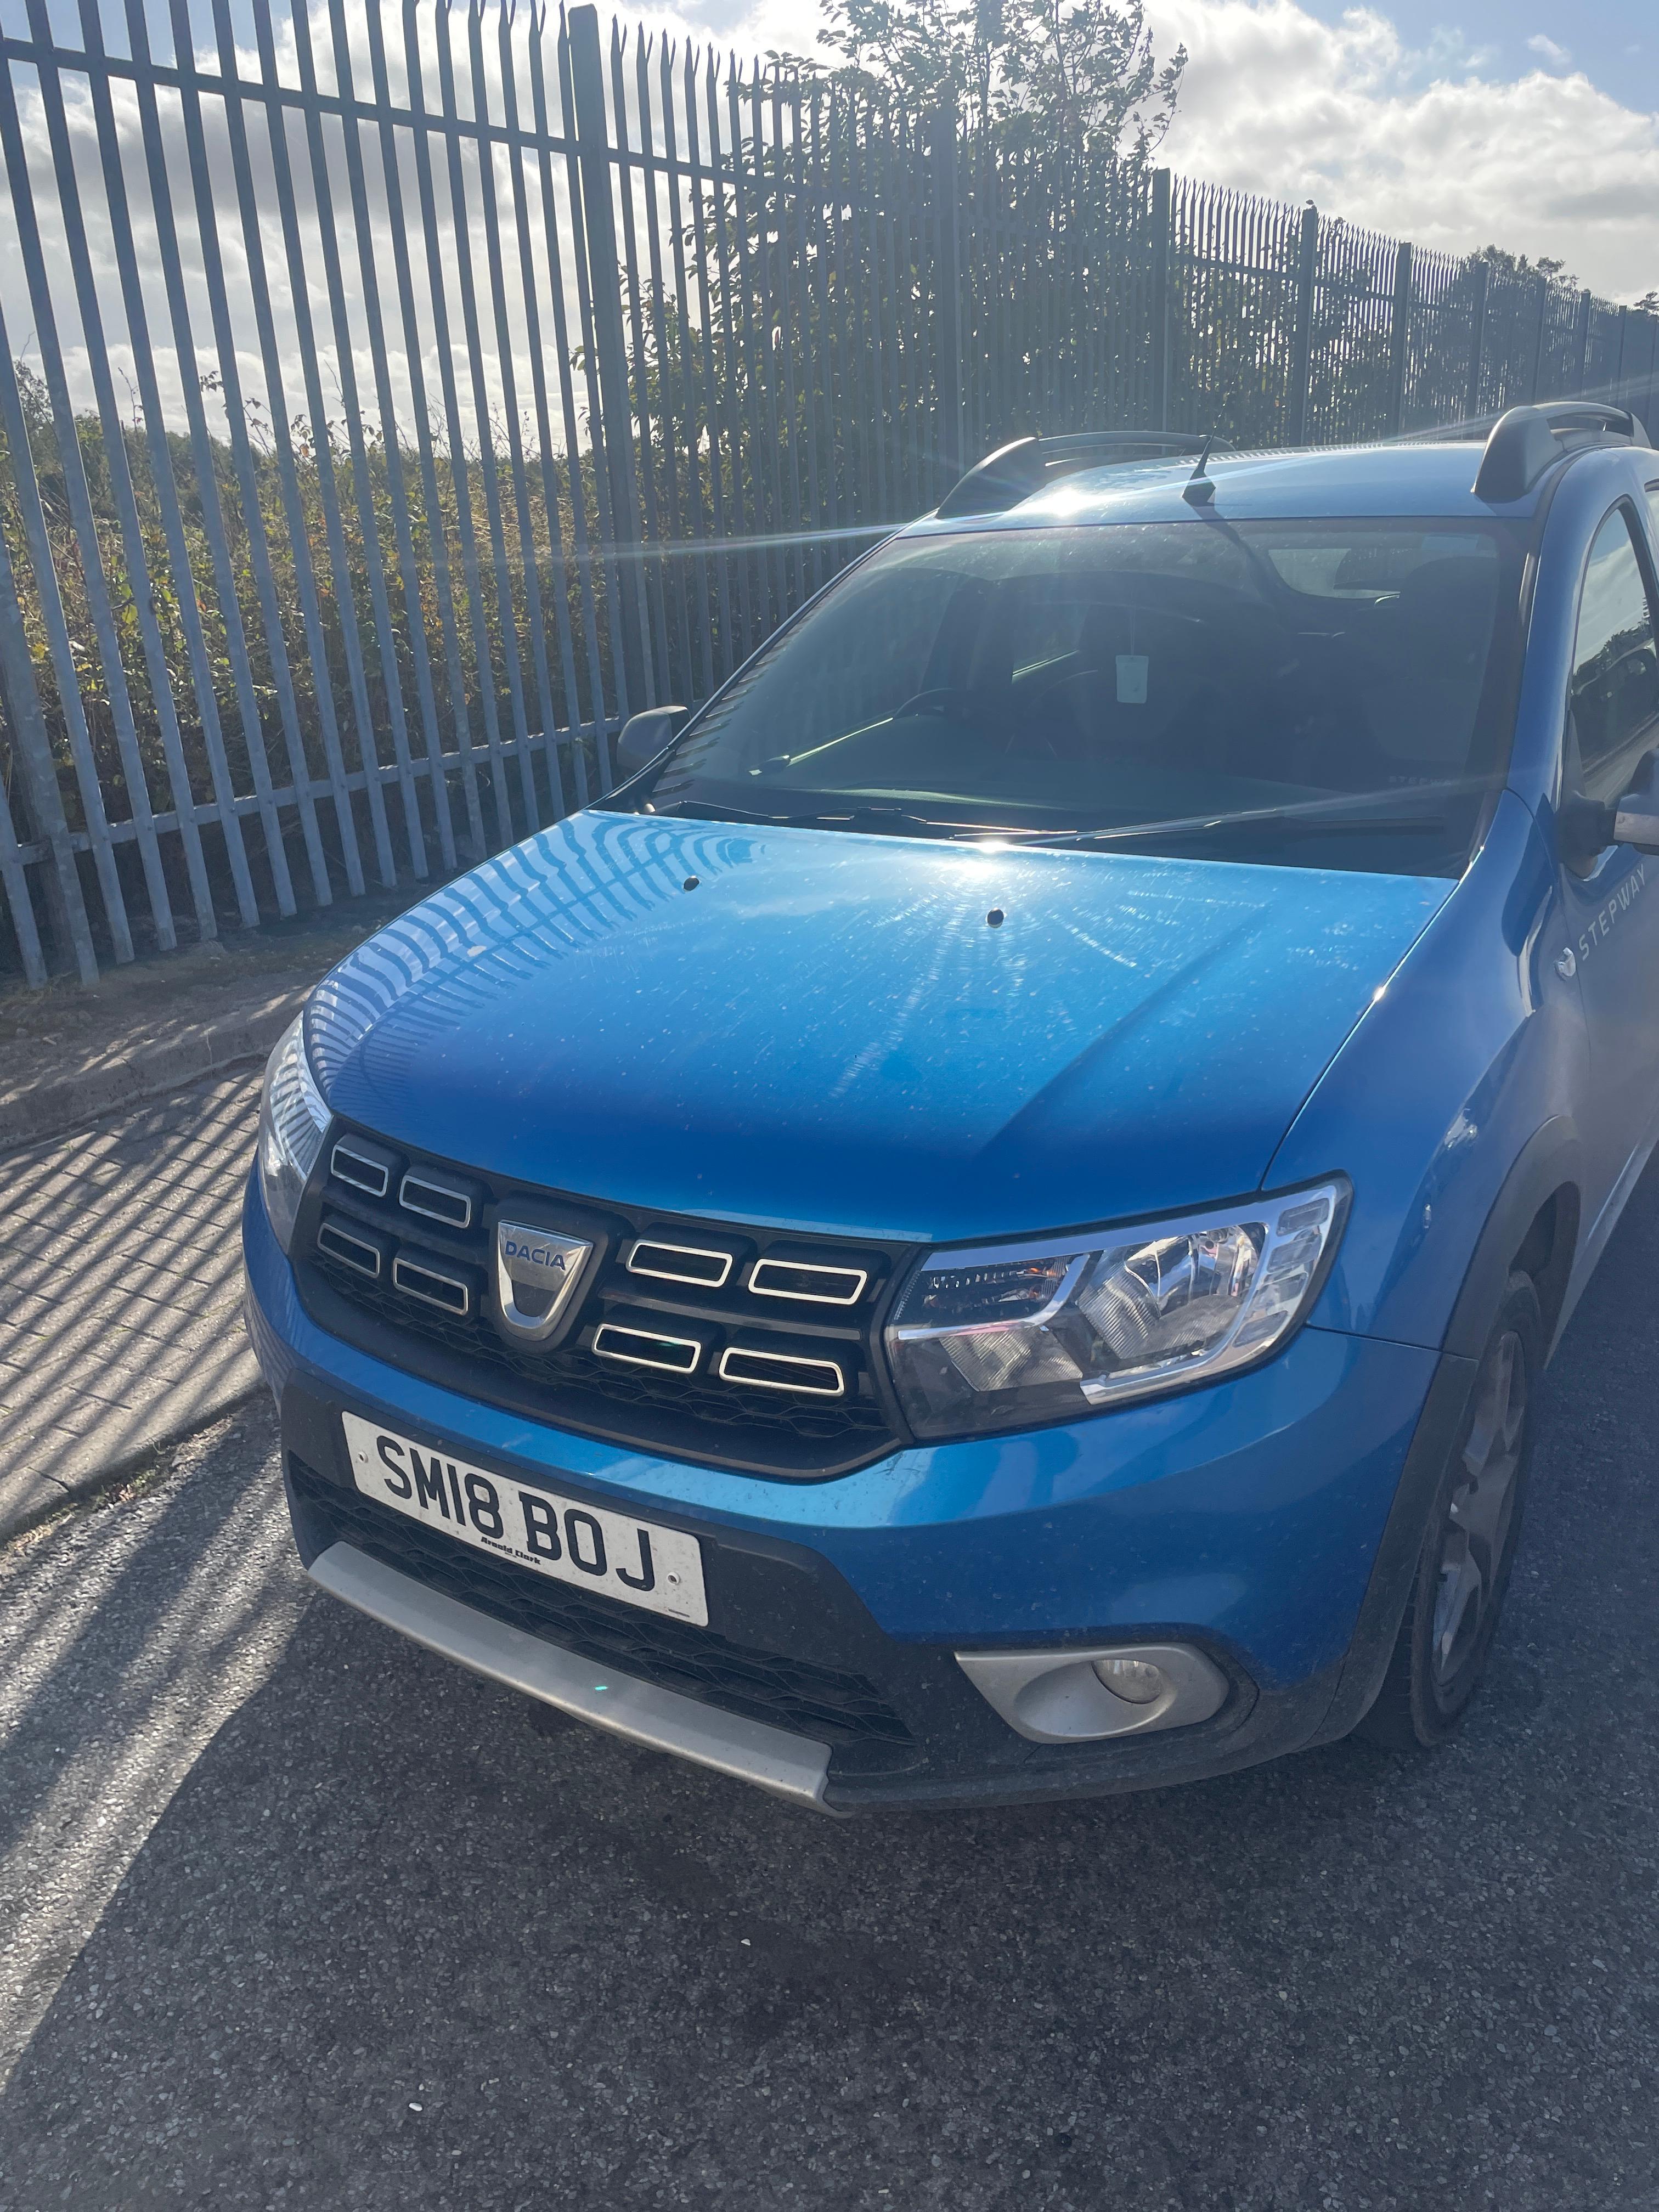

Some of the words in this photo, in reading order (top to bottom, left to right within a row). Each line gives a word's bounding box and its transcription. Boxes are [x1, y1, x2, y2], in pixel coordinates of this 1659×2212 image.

[1578, 863, 1646, 961] STEPWAY
[505, 1240, 566, 1271] DACIA
[376, 1435, 504, 1539] SM18
[519, 1491, 655, 1592] BOJ
[481, 1536, 513, 1554] Arnold
[515, 1549, 541, 1565] Clark
